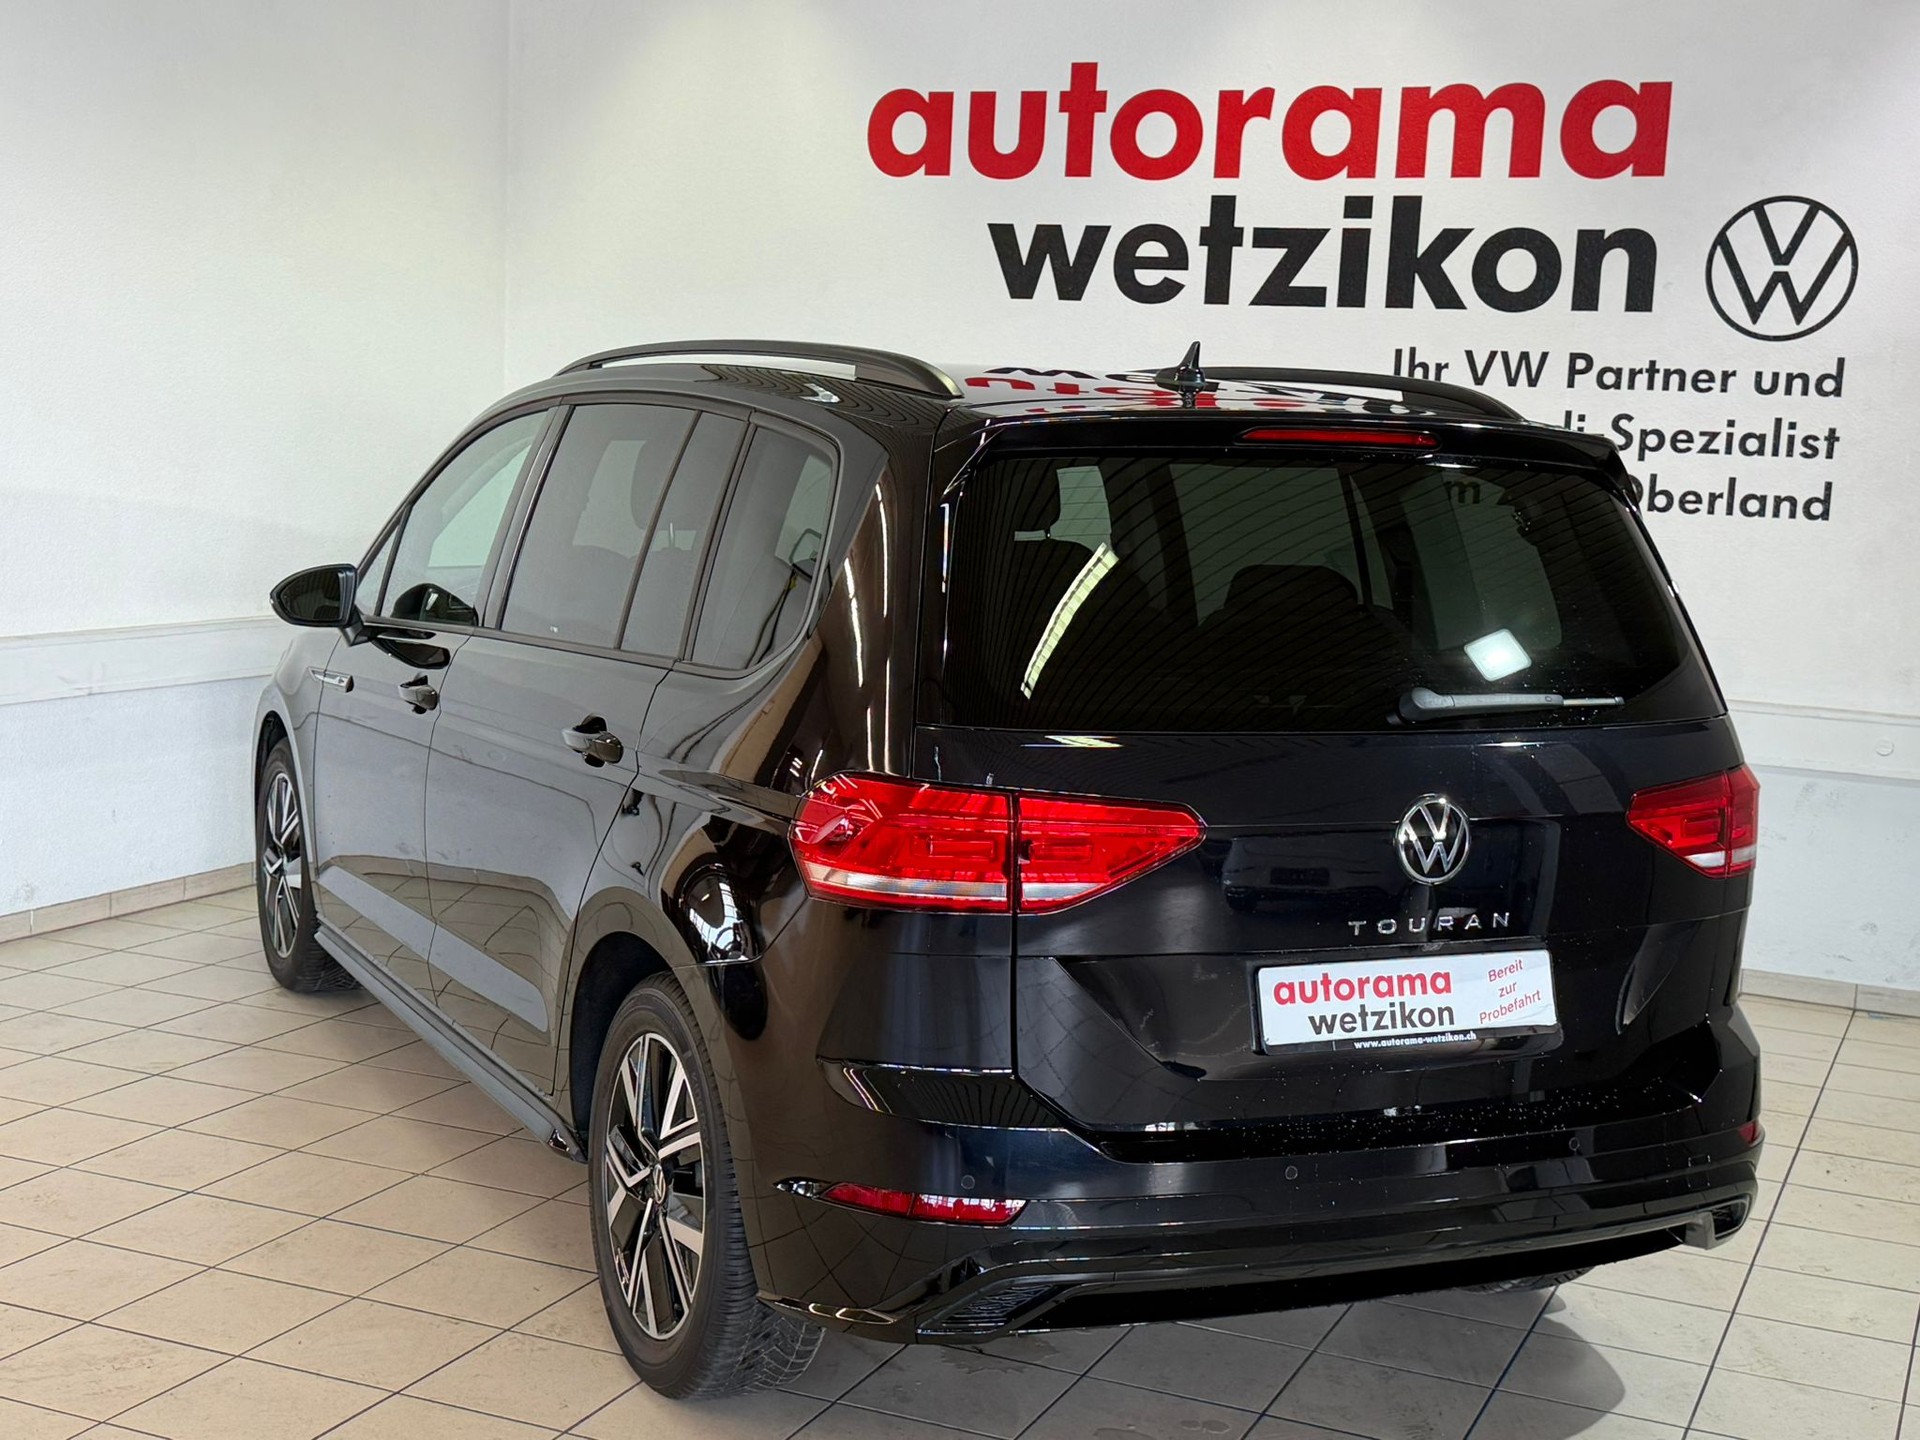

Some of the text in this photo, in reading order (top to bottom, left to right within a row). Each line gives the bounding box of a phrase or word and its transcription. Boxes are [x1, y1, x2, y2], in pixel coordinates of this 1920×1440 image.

[868, 63, 1672, 181] autorama
[988, 195, 1657, 312] wetzikon
[1393, 346, 1846, 398] Ihr VW Partner und
[1347, 911, 1510, 937] TOURAN
[1488, 959, 1523, 982] Bereit
[1273, 971, 1452, 1006] autorama
[1498, 982, 1517, 998] zur
[1308, 1001, 1455, 1035] wetzikon
[1479, 989, 1541, 1024] Probefahrt
[1353, 1031, 1477, 1049] www.autorama-wetzikon.ch
